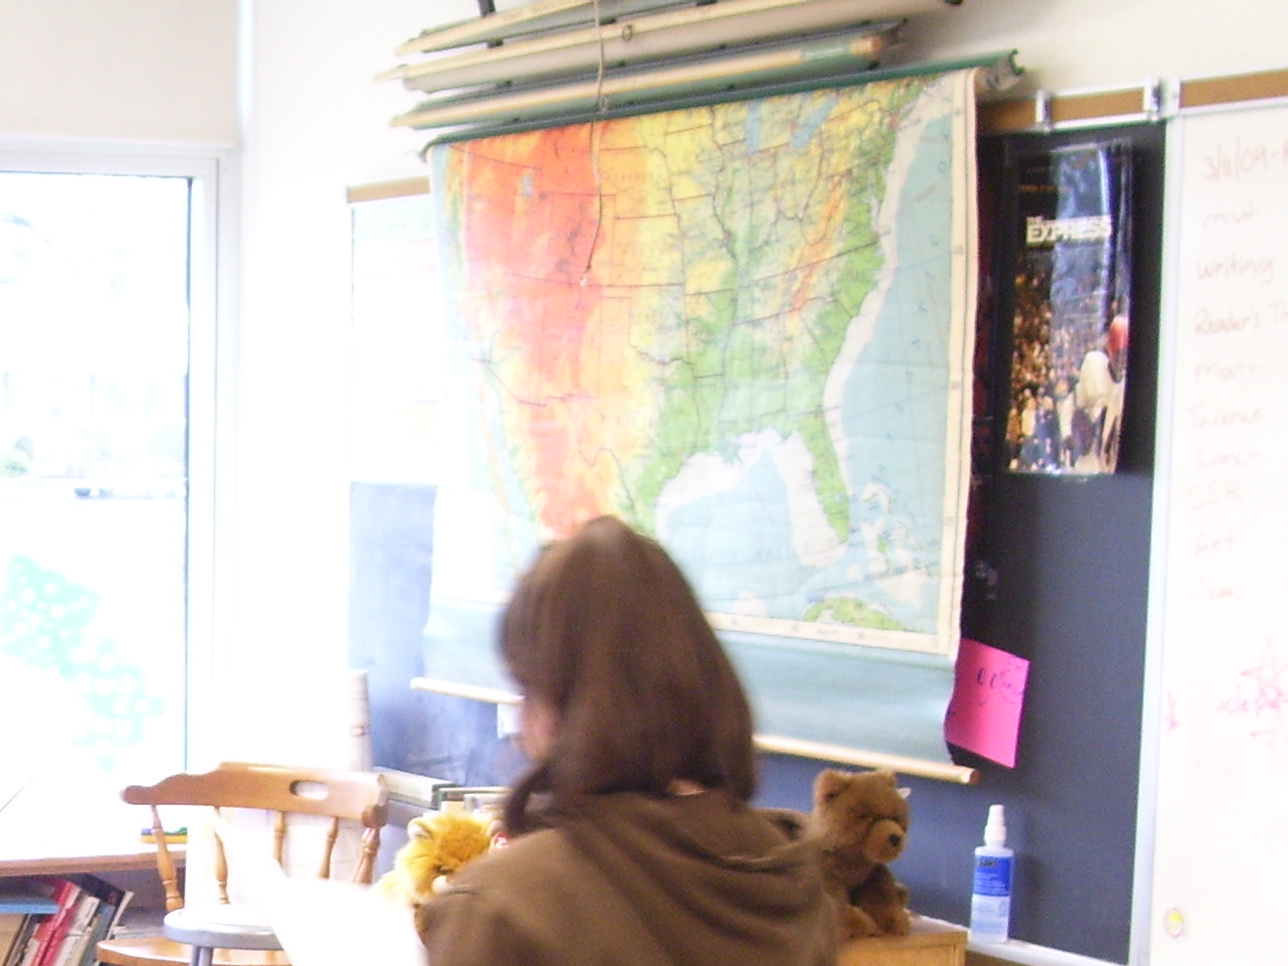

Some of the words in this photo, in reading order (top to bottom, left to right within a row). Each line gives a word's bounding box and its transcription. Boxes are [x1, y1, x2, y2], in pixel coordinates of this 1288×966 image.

[1026, 217, 1112, 243] EXPRESS
[1196, 254, 1274, 285] Writing
[1187, 400, 1264, 428] Science
[1196, 442, 1265, 470] Lunch
[1194, 529, 1241, 558] Art
